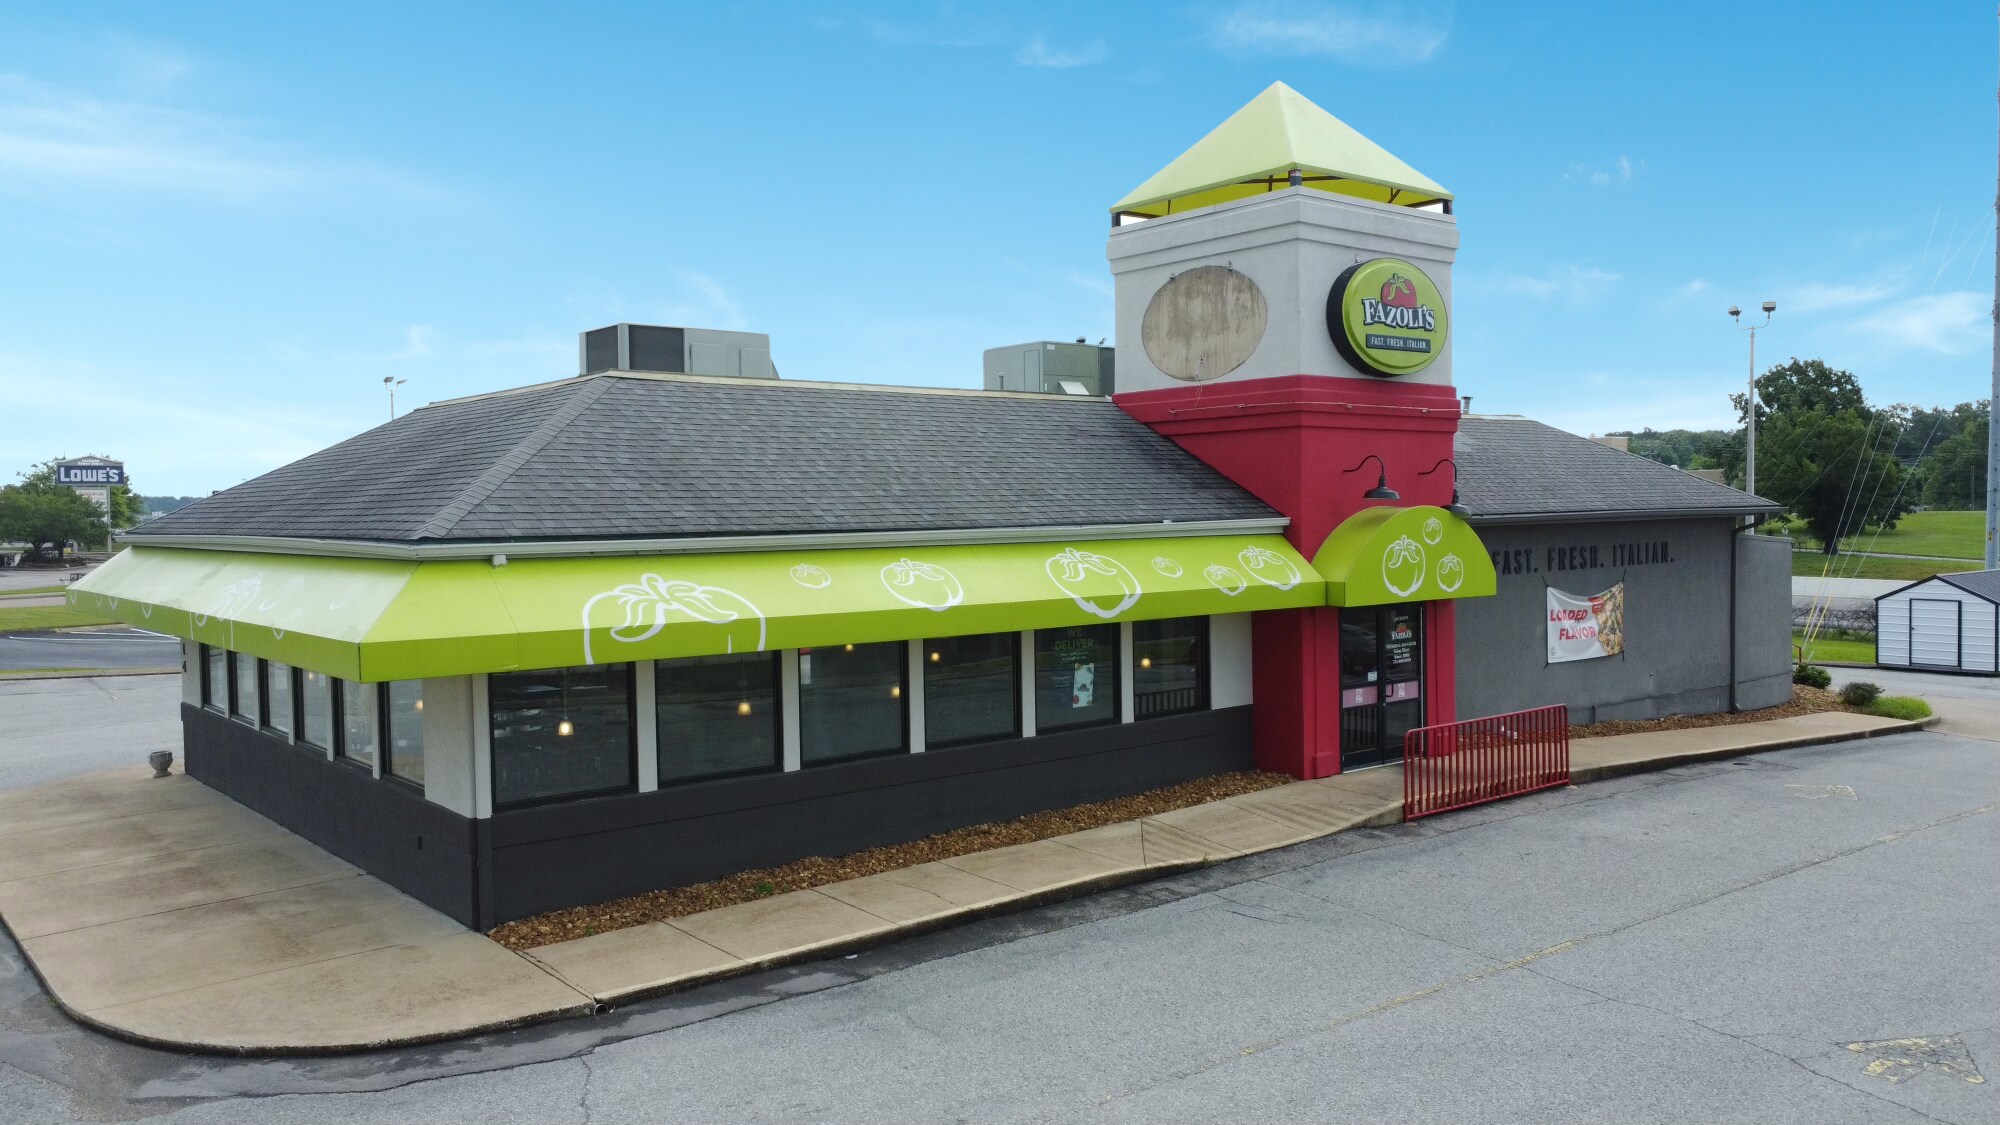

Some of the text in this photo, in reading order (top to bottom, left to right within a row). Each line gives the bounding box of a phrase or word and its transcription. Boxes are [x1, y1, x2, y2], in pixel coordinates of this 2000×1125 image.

[1362, 298, 1435, 331] FAZOLI'S
[1371, 337, 1428, 348] FAST. FRESH. ITALIAN.
[60, 467, 119, 482] LOWE'S
[1492, 541, 1675, 575] FAST. FRESH. ITALIAN.
[1550, 609, 1588, 622] LOADED
[1559, 626, 1596, 640] FLAVOR
[1055, 638, 1094, 650] DELIVER
